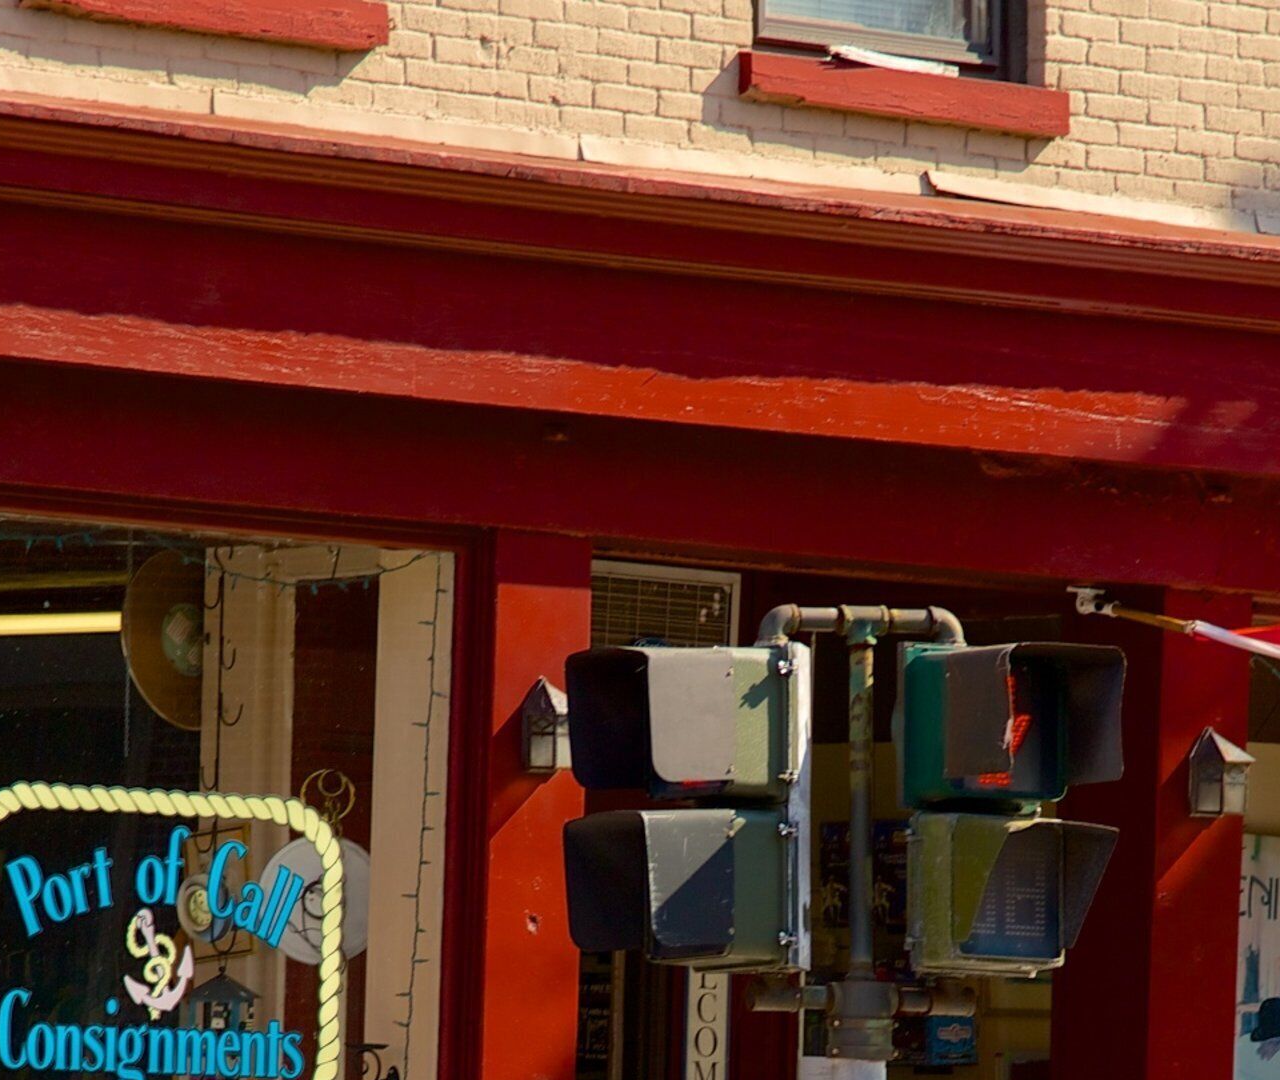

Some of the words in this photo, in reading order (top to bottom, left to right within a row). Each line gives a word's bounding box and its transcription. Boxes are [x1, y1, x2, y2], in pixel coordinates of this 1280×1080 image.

[7, 846, 114, 938] Port
[136, 825, 192, 906] of
[207, 840, 305, 949] Call
